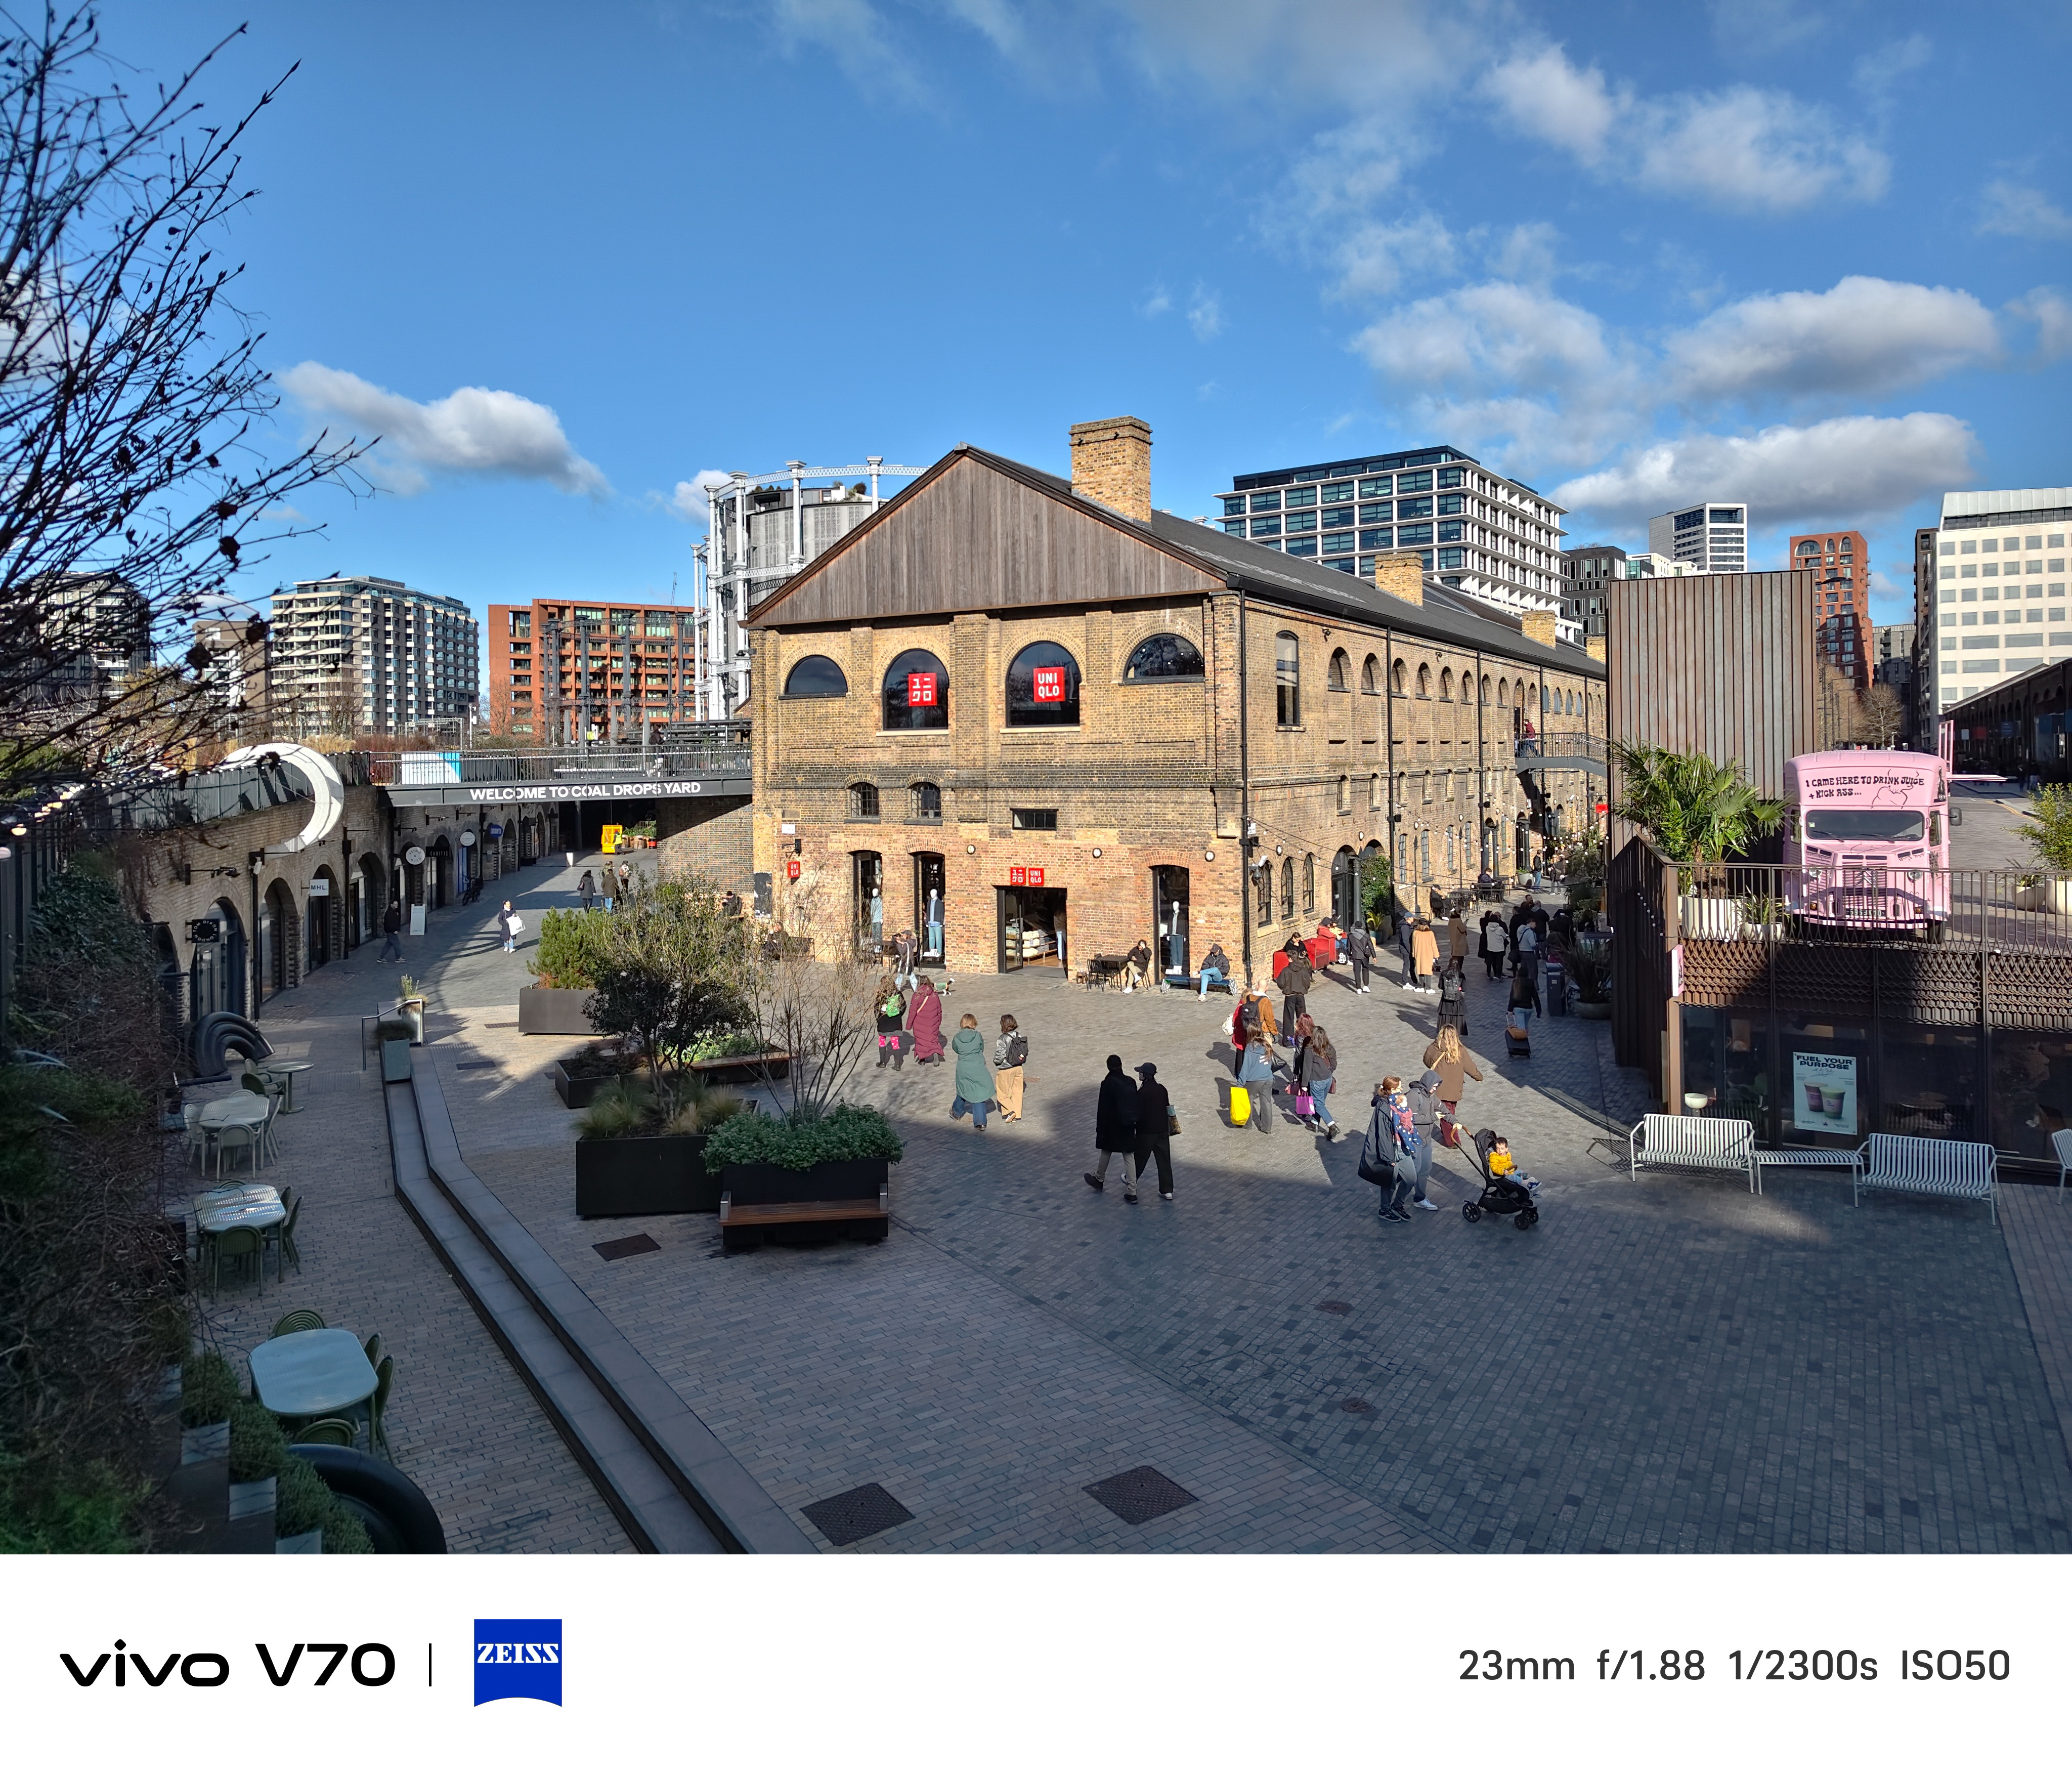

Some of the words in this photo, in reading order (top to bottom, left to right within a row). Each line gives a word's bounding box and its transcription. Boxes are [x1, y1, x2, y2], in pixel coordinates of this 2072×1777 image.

[913, 678, 931, 689] ユニ
[1038, 672, 1057, 684] UNI
[912, 691, 931, 701] クロ
[1038, 685, 1060, 699] QLO
[1812, 778, 1835, 787] CAME
[1836, 776, 1860, 785] HERE
[1861, 776, 1872, 784] TO
[1873, 776, 1900, 785] DRINK
[1901, 777, 1925, 786] JUICE
[469, 787, 546, 800] WELCOME
[549, 787, 569, 798] TO
[571, 785, 610, 797] COAL
[613, 784, 662, 796] DROPS
[664, 782, 701, 794] YARD
[1816, 789, 1834, 798] KICK
[202, 920, 218, 932] DIXON
[1799, 1061, 1849, 1070] PURPOSE
[1824, 1057, 1852, 1065] YOUR
